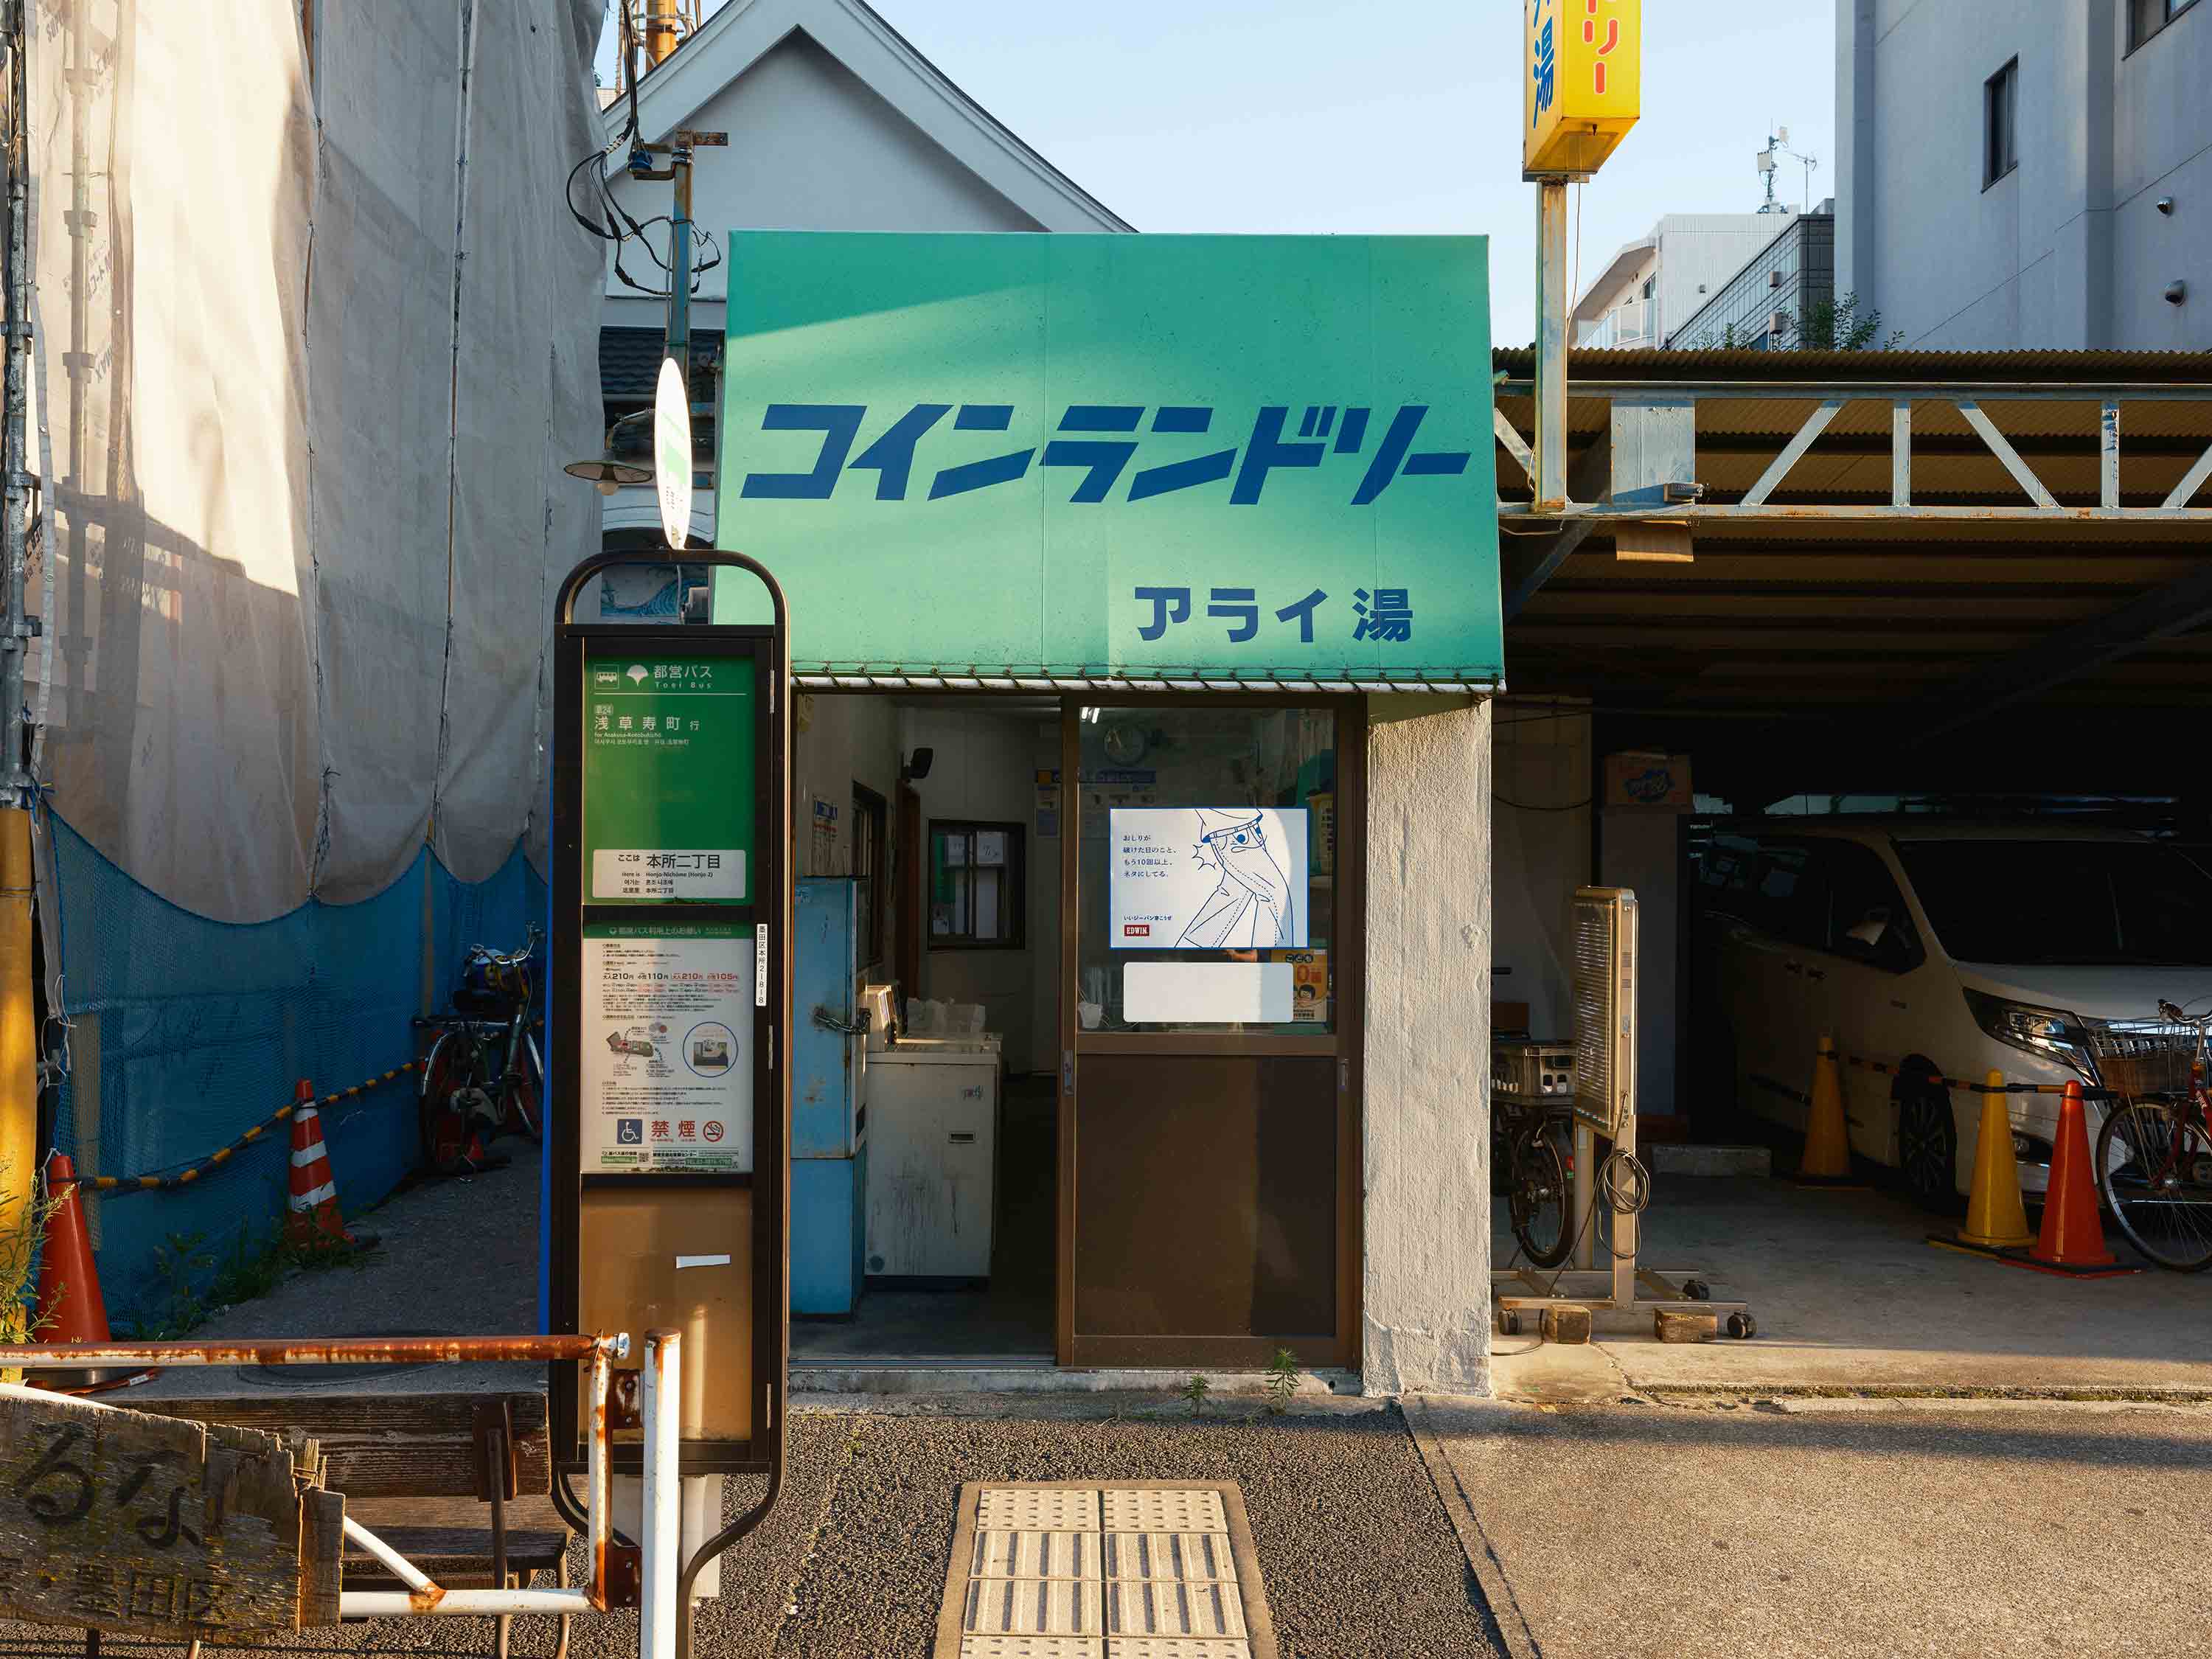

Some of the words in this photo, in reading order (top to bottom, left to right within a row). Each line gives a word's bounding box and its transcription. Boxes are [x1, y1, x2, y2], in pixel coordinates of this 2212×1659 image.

[1583, 0, 1618, 94] リー
[740, 404, 1471, 505] コインランドリー
[1135, 586, 1413, 643] アライ湯
[654, 665, 712, 678] 都営バス
[647, 854, 720, 869] 本所二丁目
[650, 1120, 696, 1138] 禁煙
